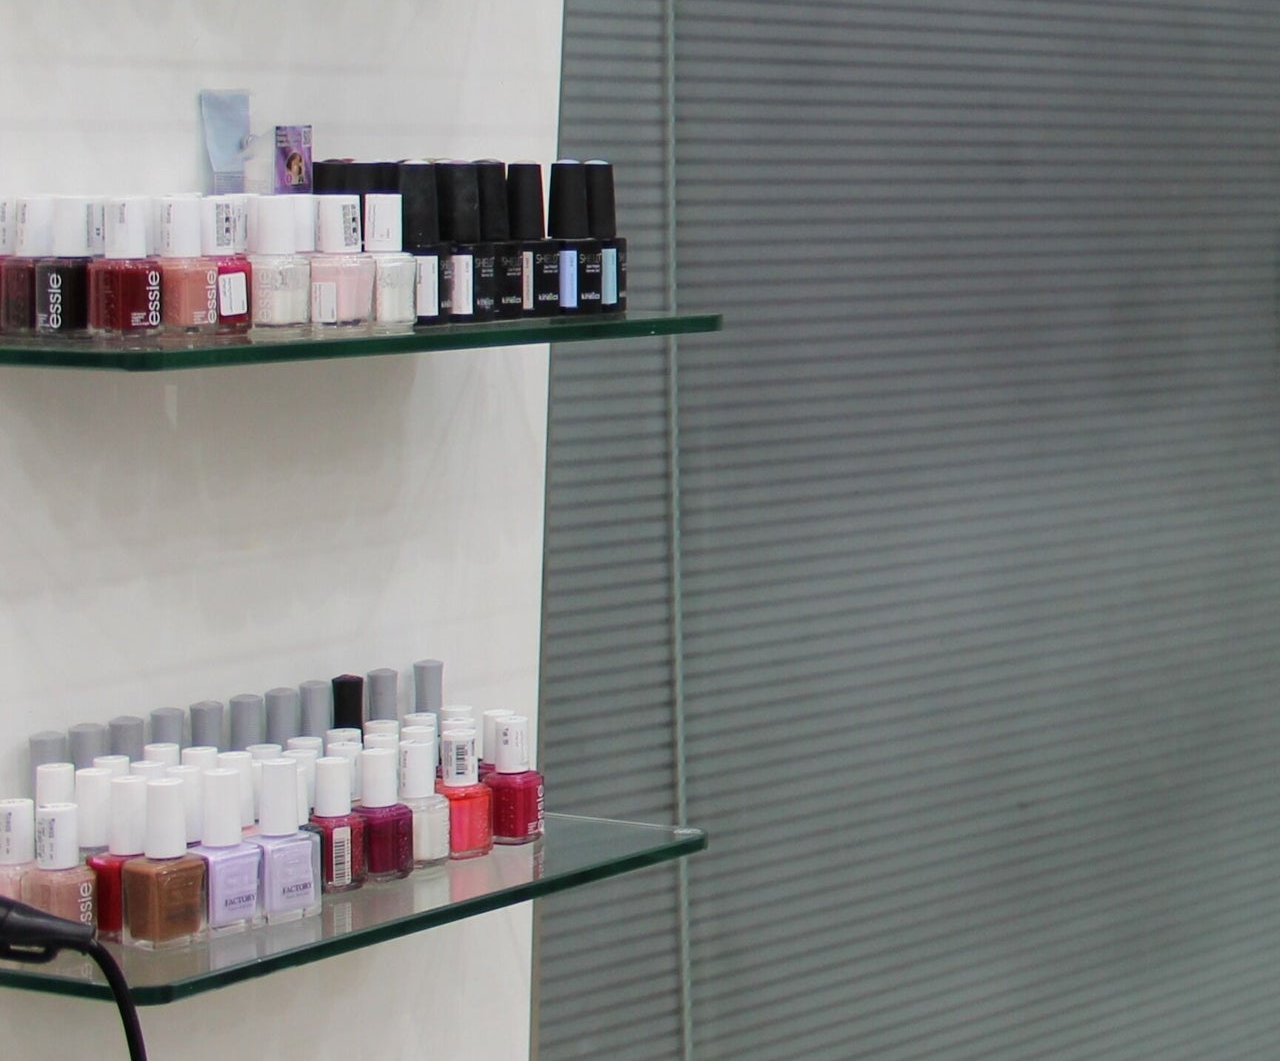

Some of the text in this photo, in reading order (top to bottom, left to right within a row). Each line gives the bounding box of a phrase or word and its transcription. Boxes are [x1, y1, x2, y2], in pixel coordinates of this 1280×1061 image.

[48, 272, 62, 329] essie
[148, 270, 161, 326] essie
[206, 269, 218, 324] essie
[259, 270, 272, 321] essie
[79, 881, 93, 926] ssie
